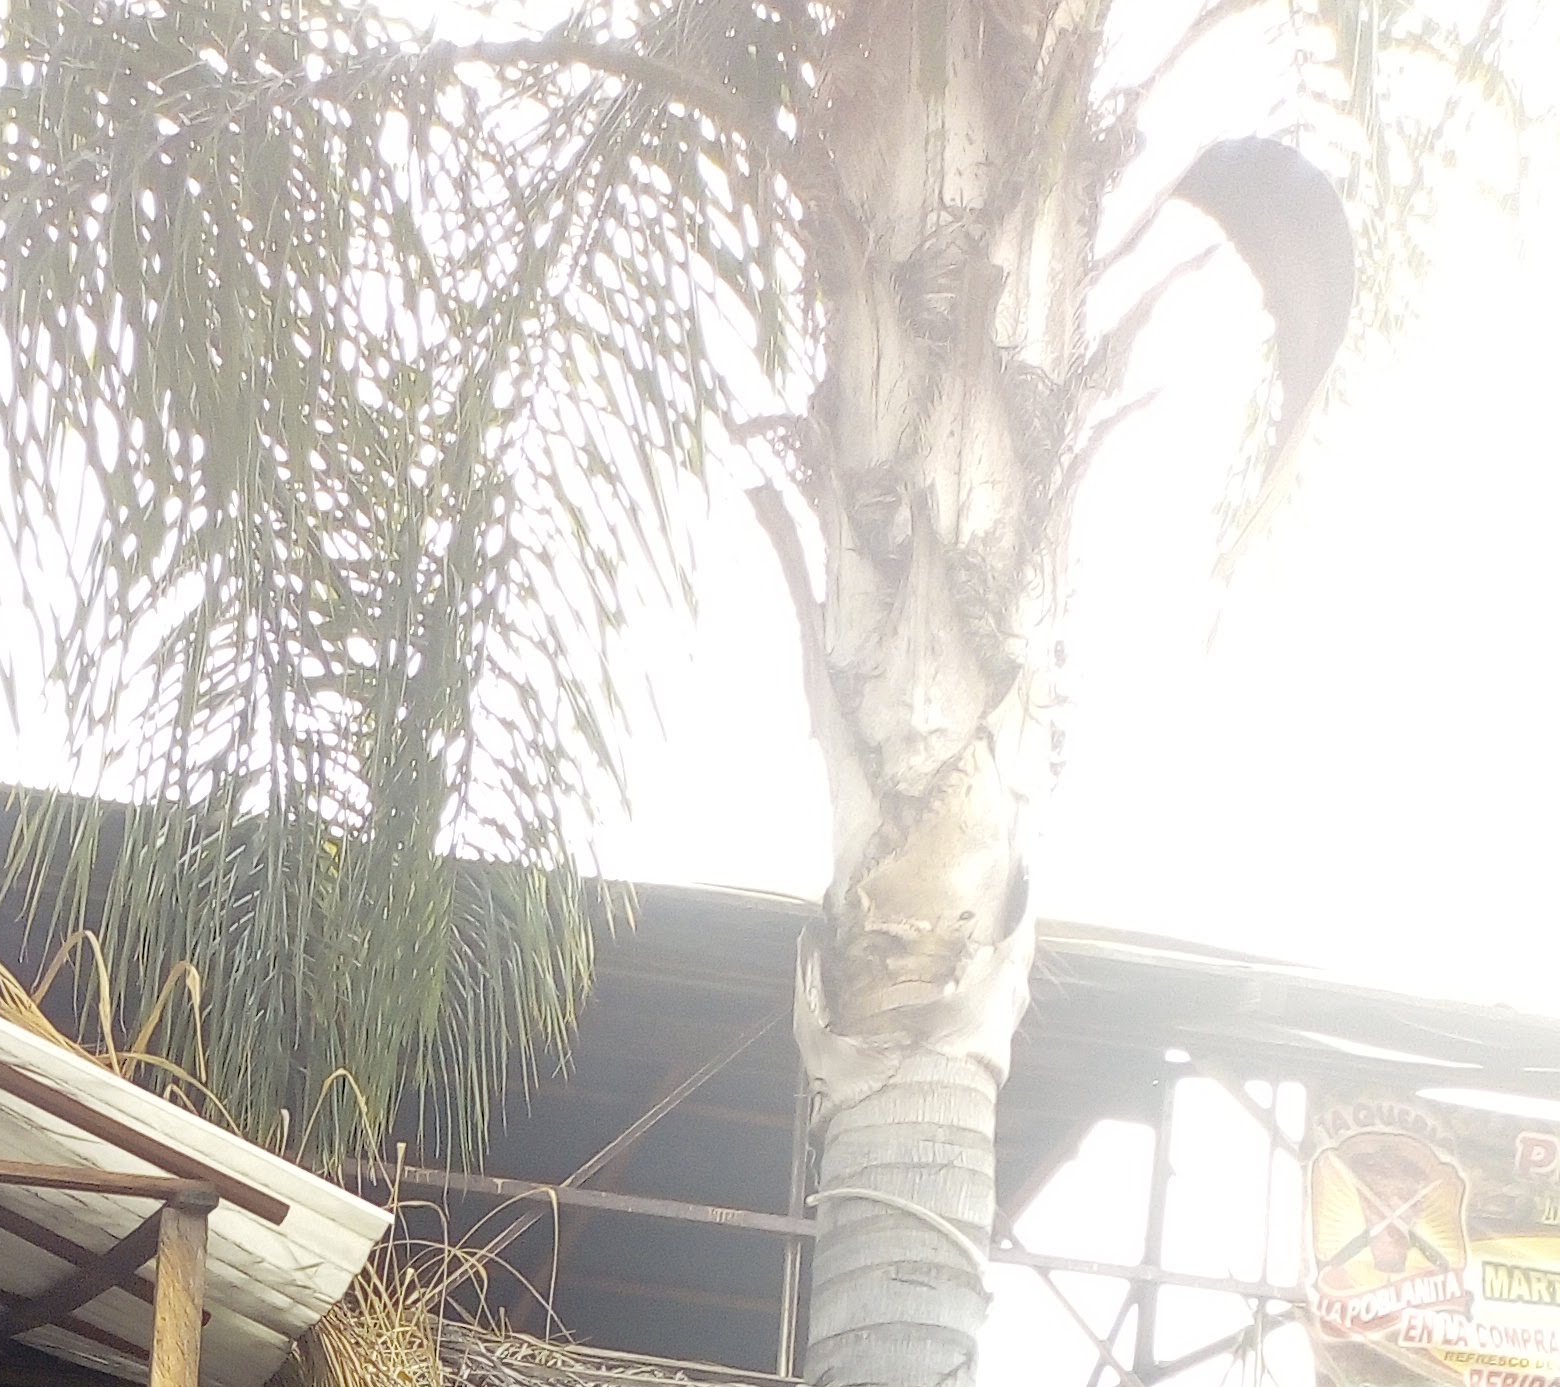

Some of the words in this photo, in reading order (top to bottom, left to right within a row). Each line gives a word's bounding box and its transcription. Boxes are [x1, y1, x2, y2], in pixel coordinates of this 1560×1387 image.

[1346, 1271, 1462, 1327] POBLANITA
[1404, 1314, 1435, 1345] EN
[1475, 1323, 1560, 1354] COMPRA
[1444, 1351, 1530, 1368] REFRESCO
